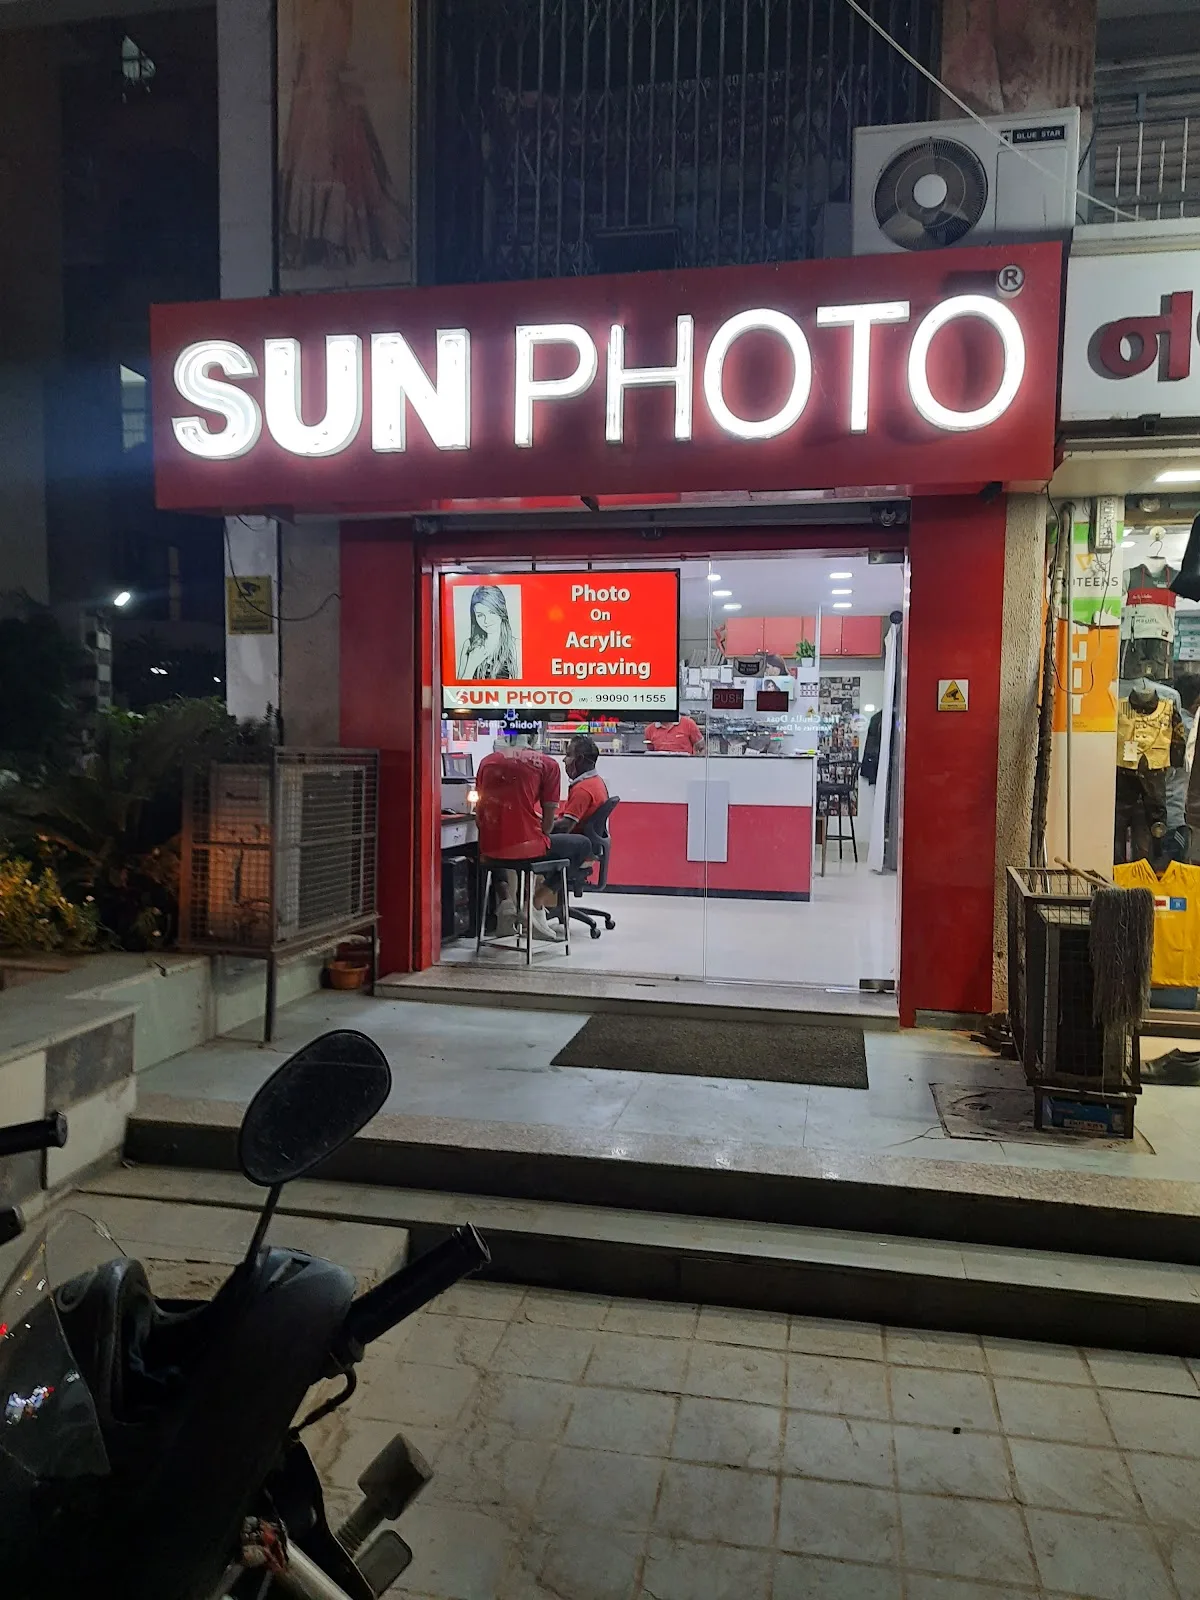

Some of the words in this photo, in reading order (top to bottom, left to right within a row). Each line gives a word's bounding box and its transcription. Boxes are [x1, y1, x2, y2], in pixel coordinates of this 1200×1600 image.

[1016, 131, 1037, 140] BLUE
[1041, 129, 1061, 138] STAR
[170, 328, 472, 461] SUN
[514, 294, 1027, 449] PHOTO
[571, 584, 631, 602] Photo
[590, 608, 611, 621] On
[565, 630, 633, 653] Acrylic
[551, 658, 651, 680] Engraving
[456, 691, 499, 705] SUN
[507, 690, 574, 705] PHOTO
[595, 694, 630, 703] 99090
[633, 694, 667, 703] 11555
[714, 693, 743, 704] PUSH
